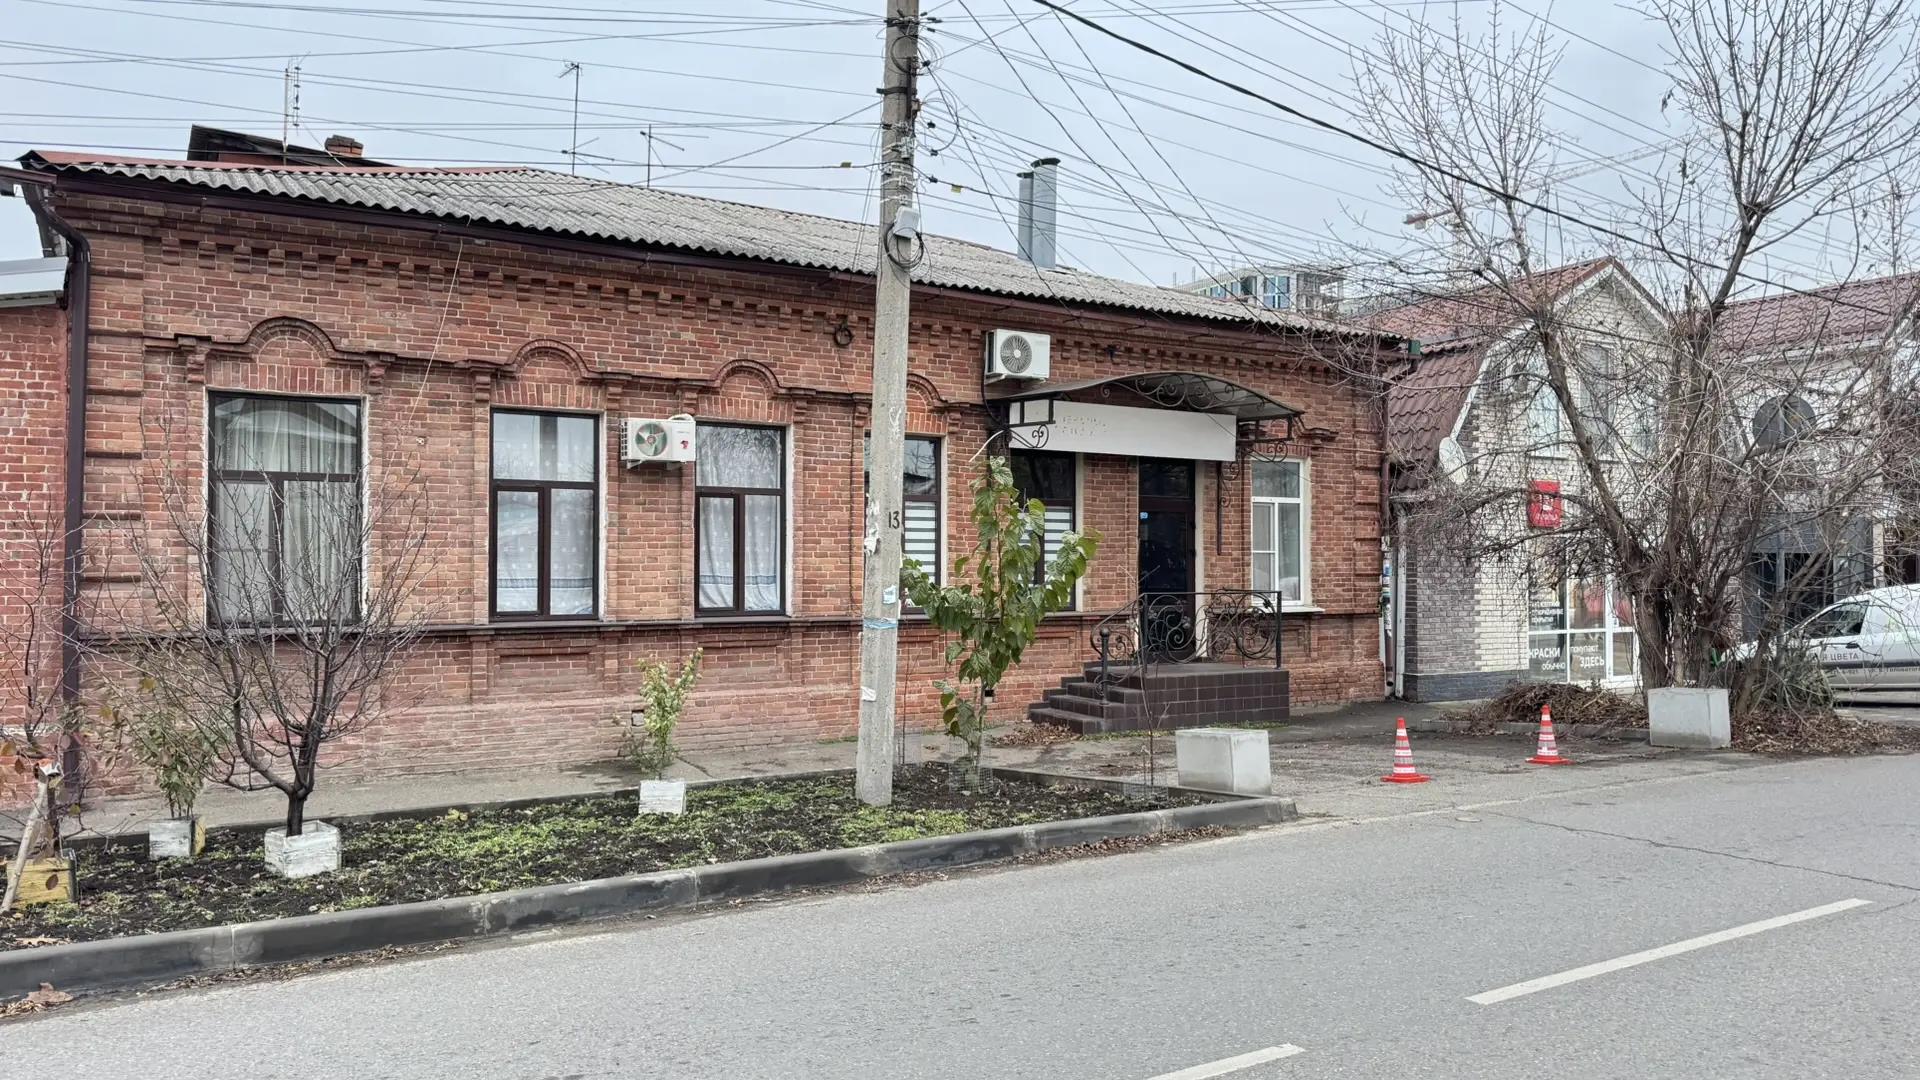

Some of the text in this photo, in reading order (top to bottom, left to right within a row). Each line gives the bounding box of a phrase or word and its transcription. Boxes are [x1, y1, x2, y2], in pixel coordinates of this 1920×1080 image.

[888, 511, 901, 529] 13
[1529, 647, 1560, 659] КРАСКИ
[1830, 652, 1859, 661] ЦВЕТА
[1580, 656, 1605, 668] ЗДЕСЬ
